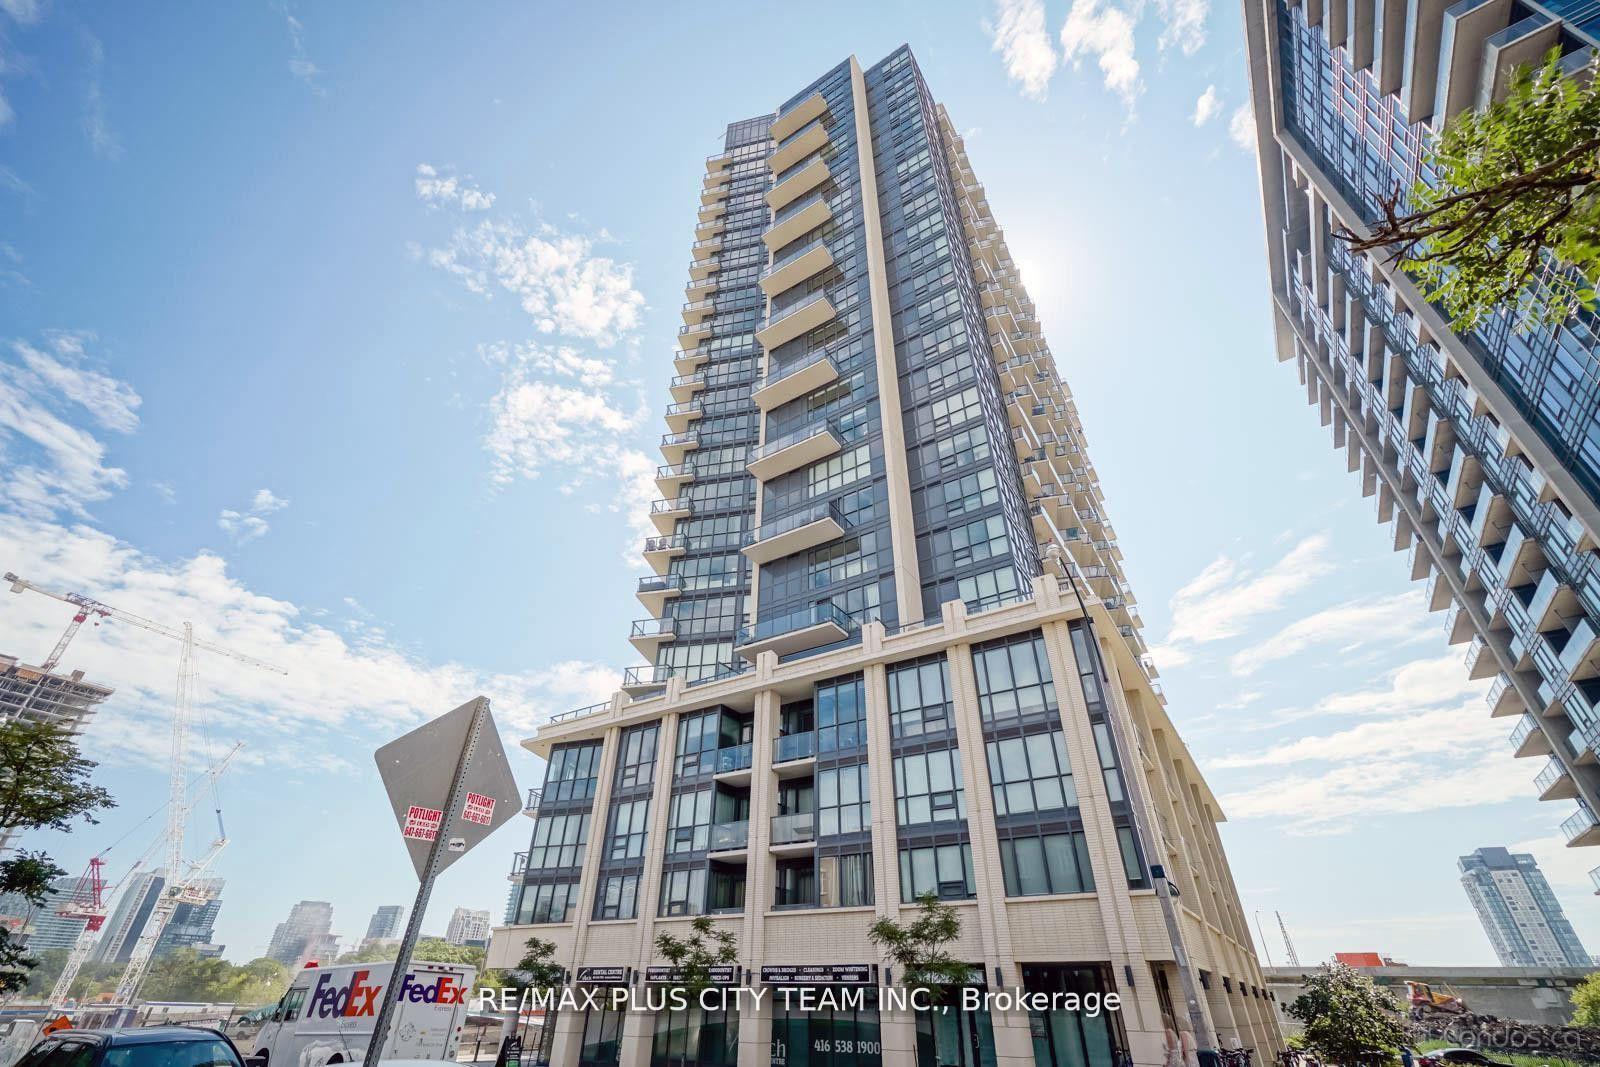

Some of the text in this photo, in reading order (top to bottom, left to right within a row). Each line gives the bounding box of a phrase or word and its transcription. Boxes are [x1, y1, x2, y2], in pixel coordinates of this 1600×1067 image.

[467, 792, 495, 809] POTLIGHT
[408, 806, 442, 822] POTLIGHT
[306, 970, 383, 1019] FedEx
[398, 974, 468, 1005] FedEx
[814, 1040, 880, 1055] 416 538 1900
